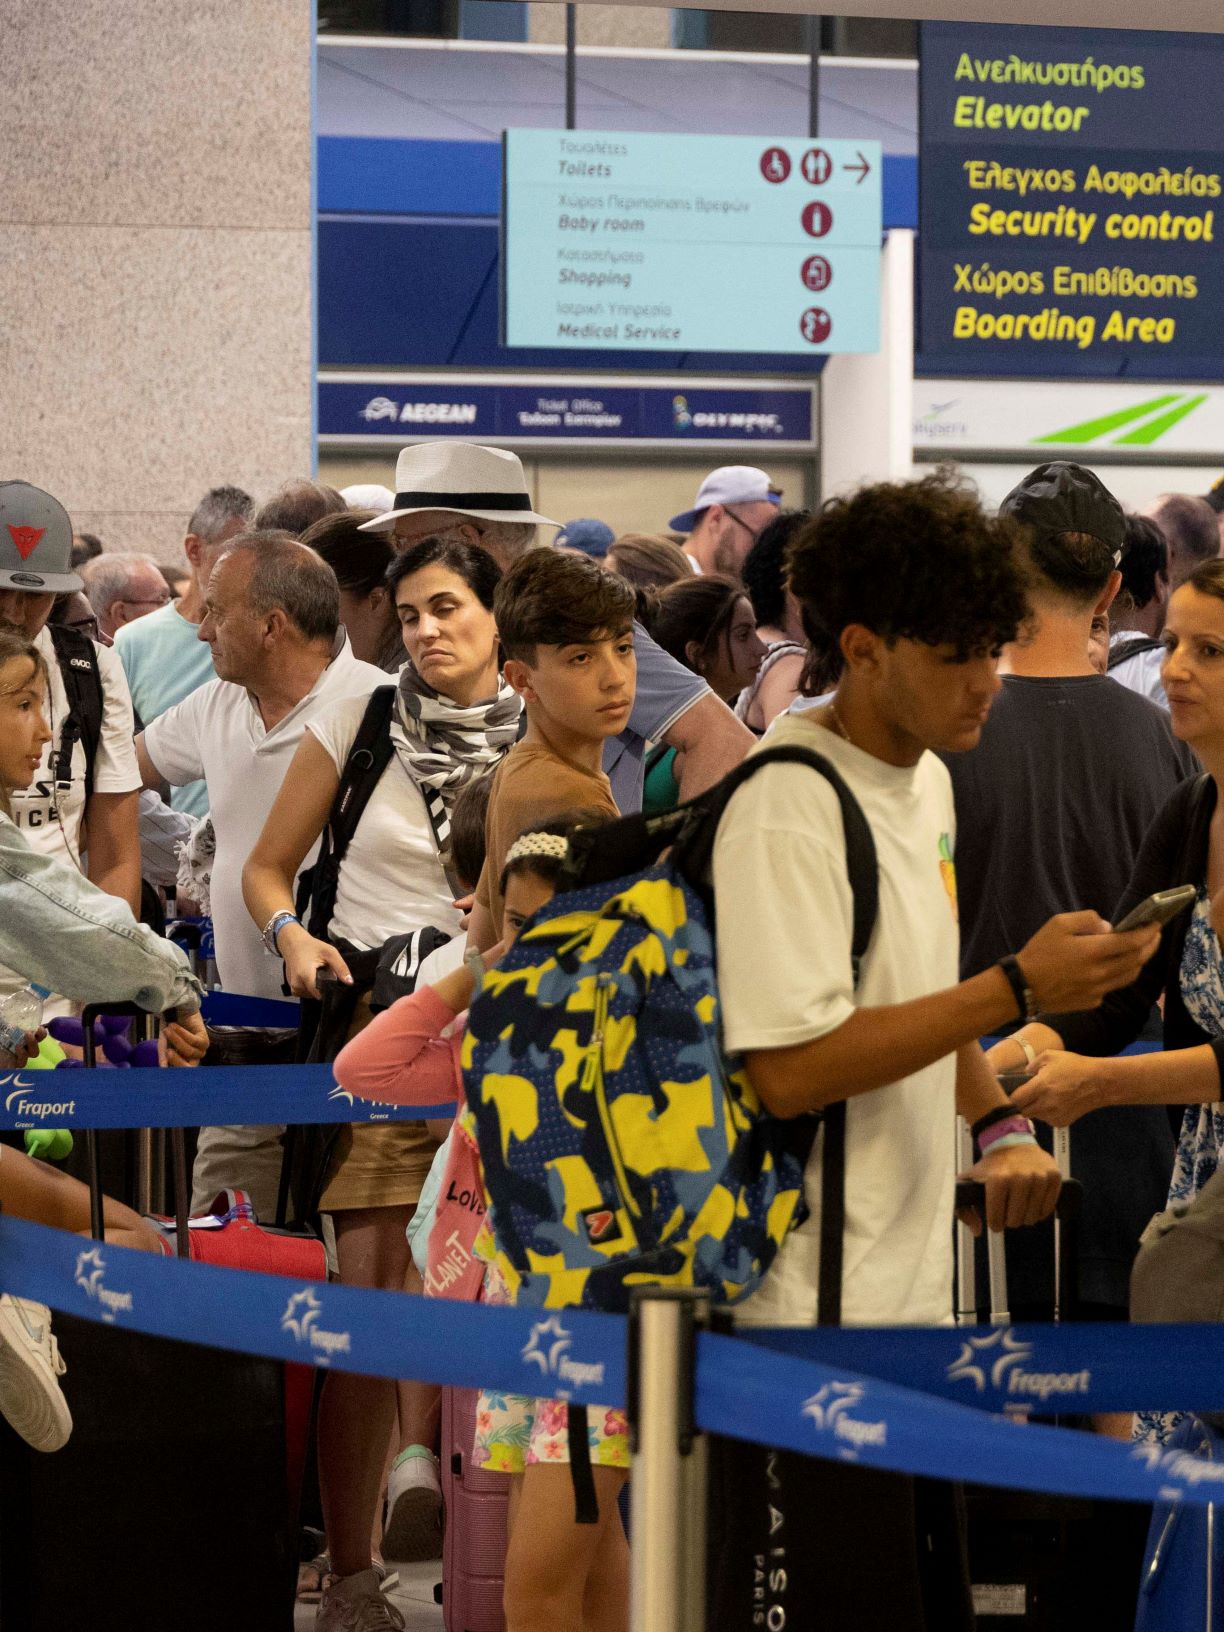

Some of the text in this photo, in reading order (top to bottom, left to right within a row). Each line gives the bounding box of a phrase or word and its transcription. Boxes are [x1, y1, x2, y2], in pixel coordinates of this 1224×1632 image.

[954, 52, 1146, 94] Ανελκυστήρας
[953, 95, 1090, 132] Elevator
[558, 160, 612, 178] Toilets
[963, 160, 1222, 200] Έλεγχος Ασφαλείας
[558, 213, 645, 234] Baby room
[968, 202, 1214, 244] Security control
[559, 268, 632, 288] Shopping
[953, 262, 1198, 299] Χώρος Επιβίβασης
[557, 323, 682, 340] Medical Service
[952, 306, 1176, 349] Boarding Area
[400, 403, 476, 423] AEGEAN
[17, 1100, 76, 1119] Fraport
[1008, 1368, 1091, 1401] Fraport
